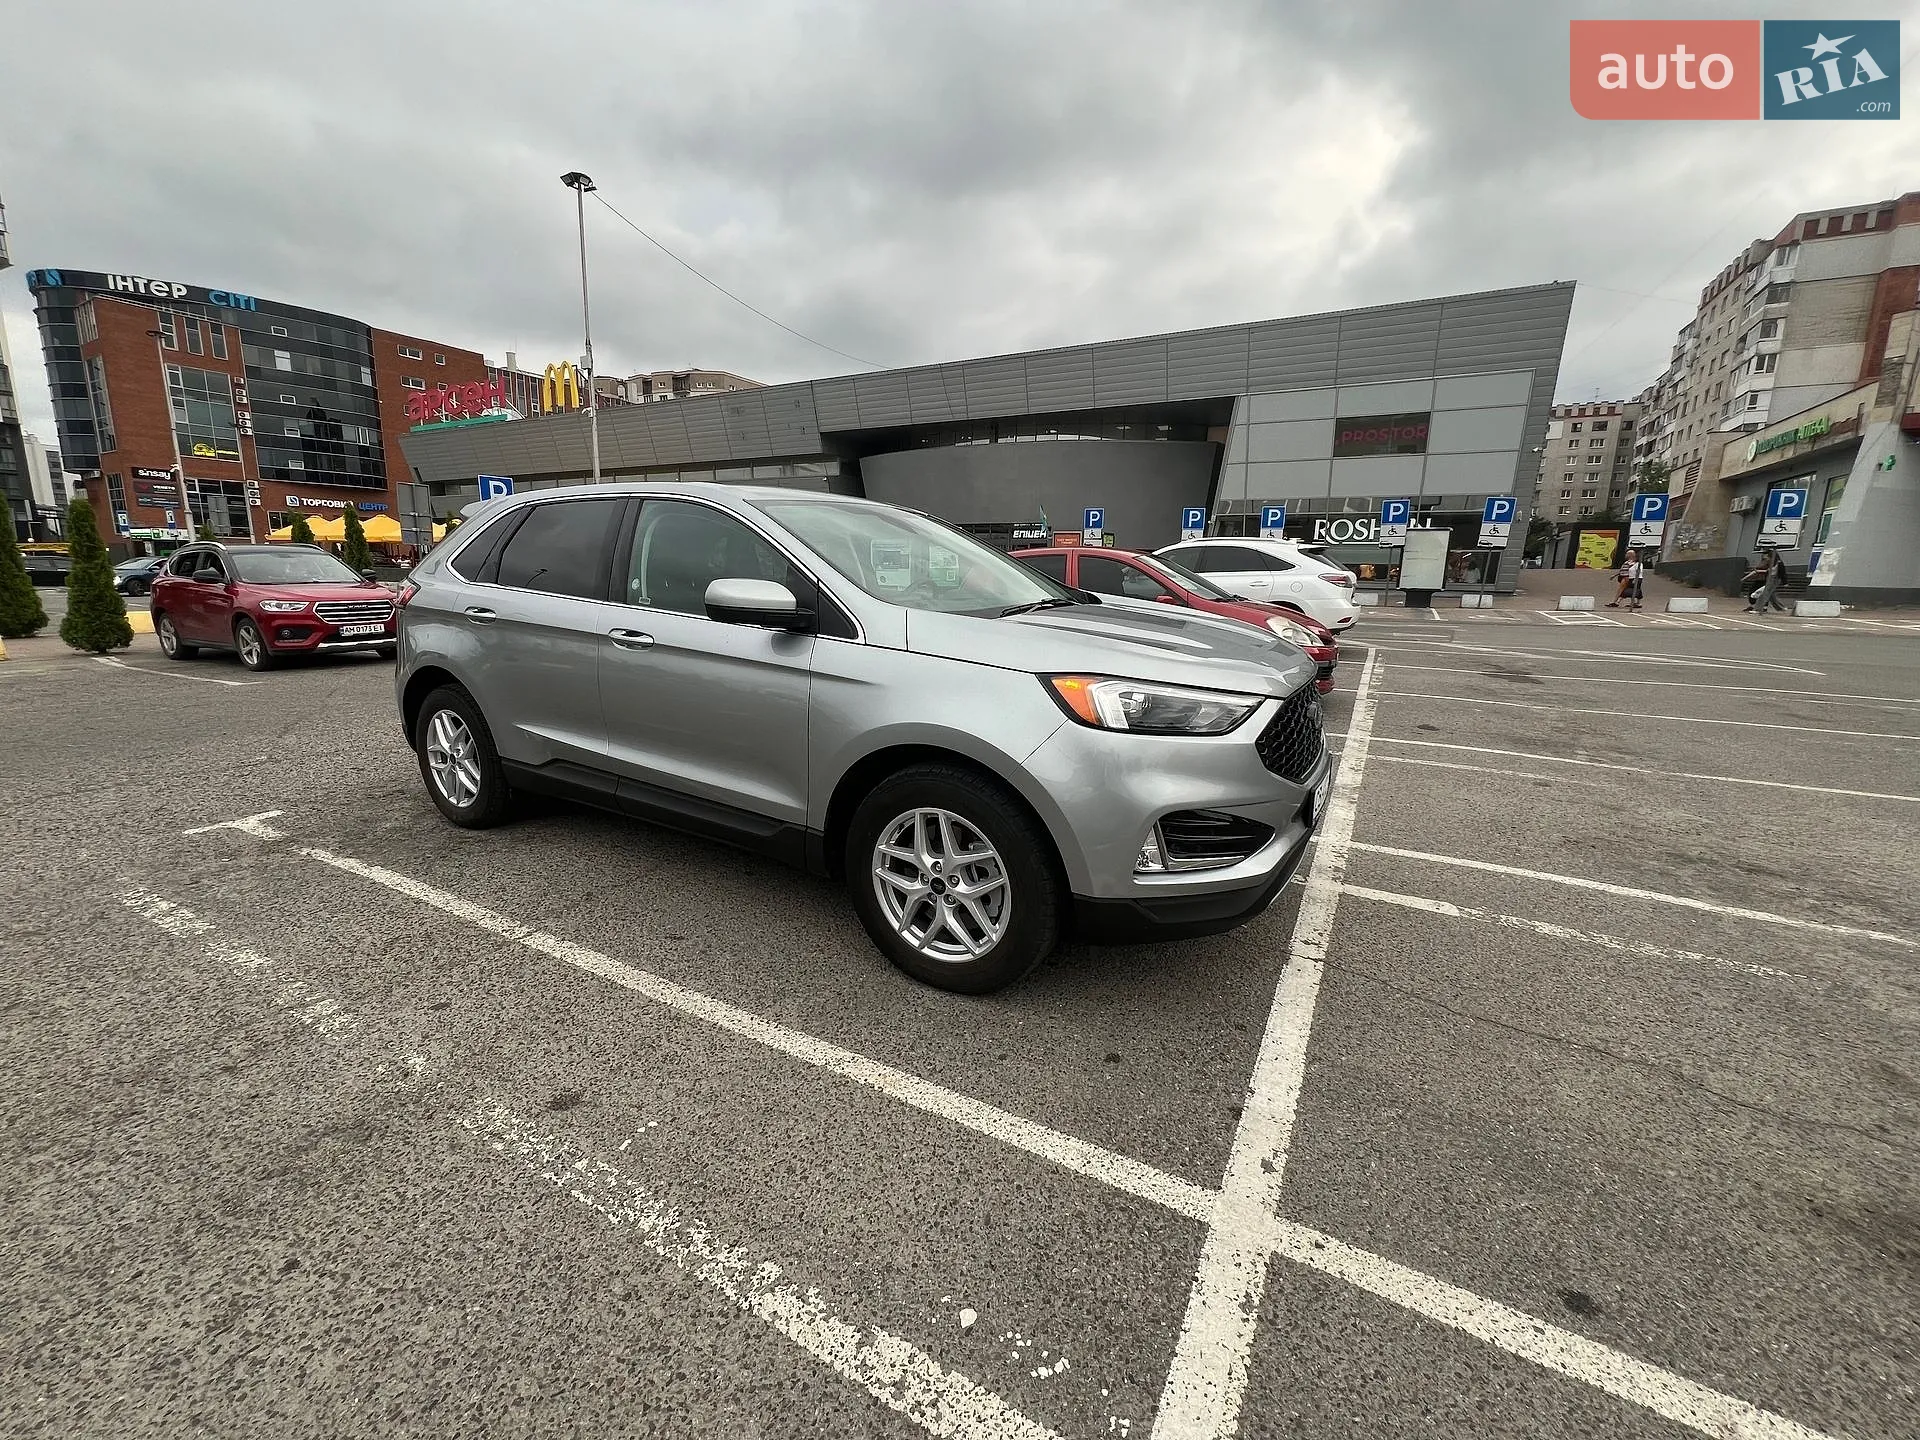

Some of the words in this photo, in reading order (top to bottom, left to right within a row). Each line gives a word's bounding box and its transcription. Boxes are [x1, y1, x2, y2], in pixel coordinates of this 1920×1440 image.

[138, 469, 171, 480] sinsay
[489, 480, 508, 499] P
[301, 497, 354, 508] ТОРГОВИ
[359, 502, 388, 511] ЦЕНТР
[1388, 503, 1404, 522] P
[1491, 500, 1510, 520] P
[1642, 497, 1662, 519] P
[1777, 492, 1799, 516] P
[1089, 511, 1100, 527] P
[1189, 510, 1201, 527] P
[1267, 509, 1281, 527] P
